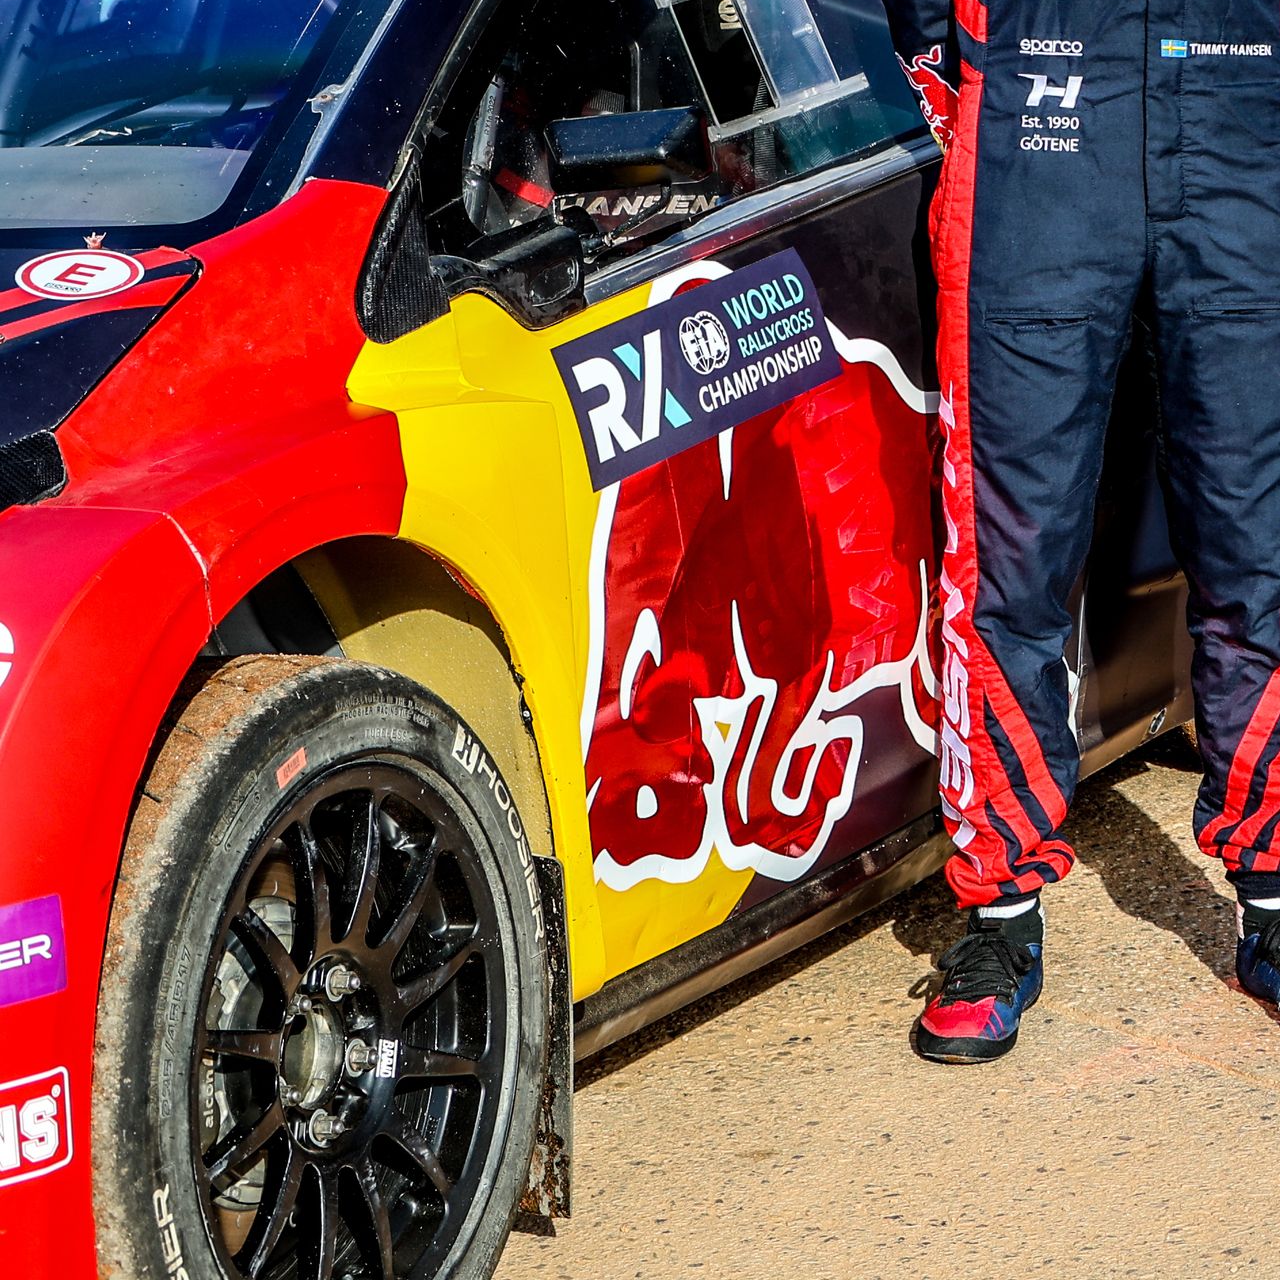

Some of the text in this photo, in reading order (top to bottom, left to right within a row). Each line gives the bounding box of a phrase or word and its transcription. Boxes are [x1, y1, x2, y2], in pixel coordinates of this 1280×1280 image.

[1020, 37, 1083, 57] sparco
[1190, 42, 1272, 57] TIMMY HANSEN
[1021, 115, 1080, 130] Est. 1990
[1020, 134, 1080, 153] GÖTENE
[53, 262, 107, 286] E
[722, 273, 805, 331] WORLD
[737, 307, 815, 359] RALLYCROSS
[698, 336, 823, 414] CHAMPIONSHIP
[571, 328, 693, 464] RX
[364, 727, 408, 740] TUBELESS
[477, 752, 545, 943] HOOSIER
